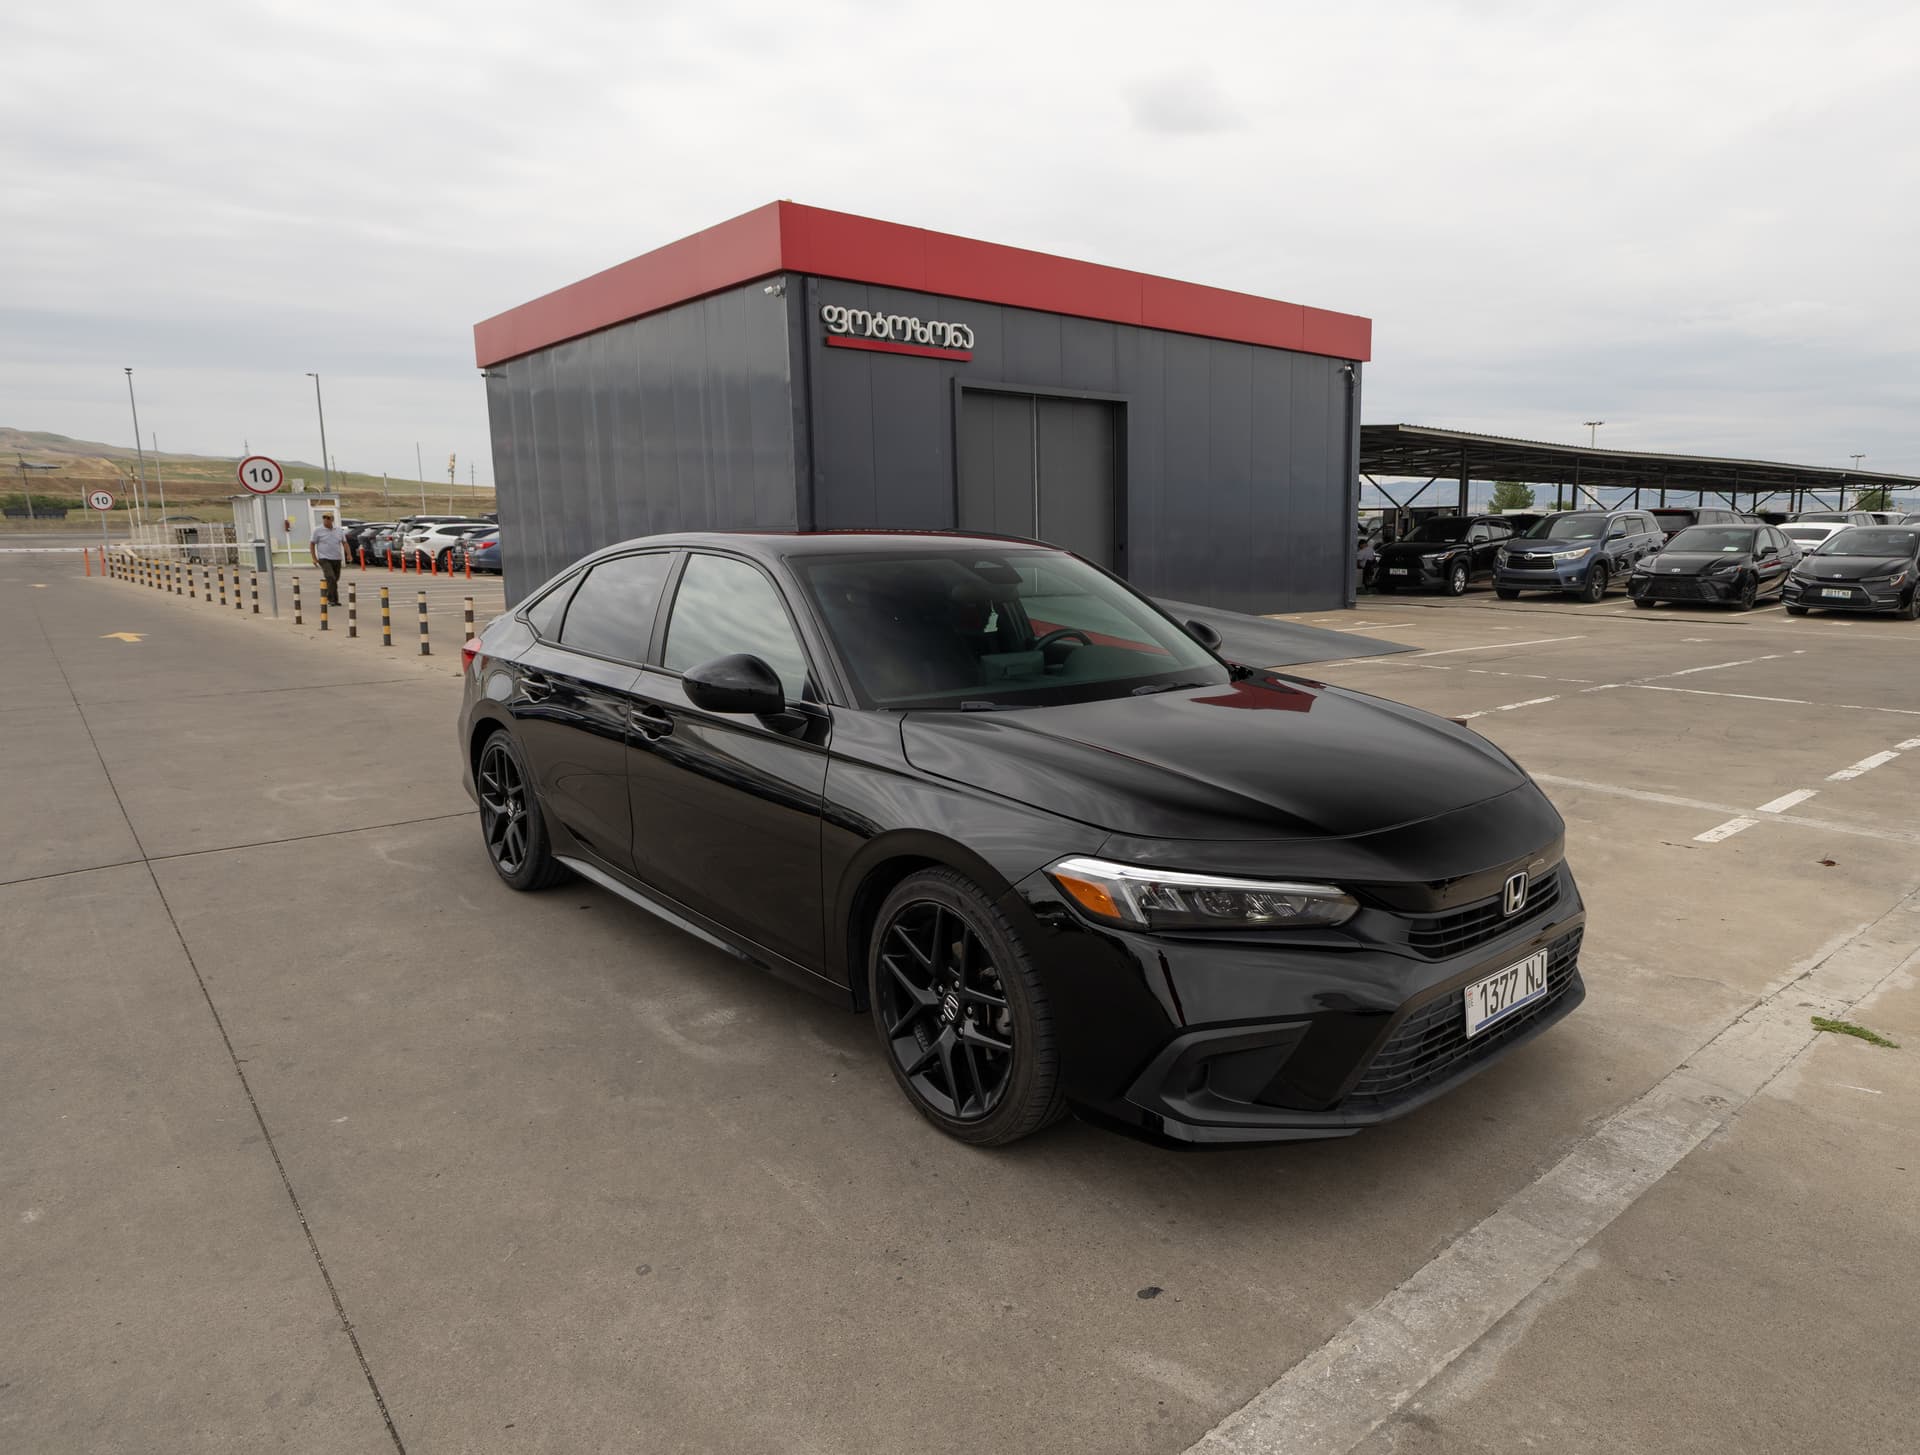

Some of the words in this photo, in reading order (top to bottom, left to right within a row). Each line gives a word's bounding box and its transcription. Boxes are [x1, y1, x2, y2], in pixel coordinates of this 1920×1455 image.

[822, 305, 974, 349] ფოტოზონა
[249, 468, 273, 483] 10
[95, 496, 108, 505] 10
[1480, 968, 1519, 1018] 1377
[1525, 954, 1544, 995] NJ
